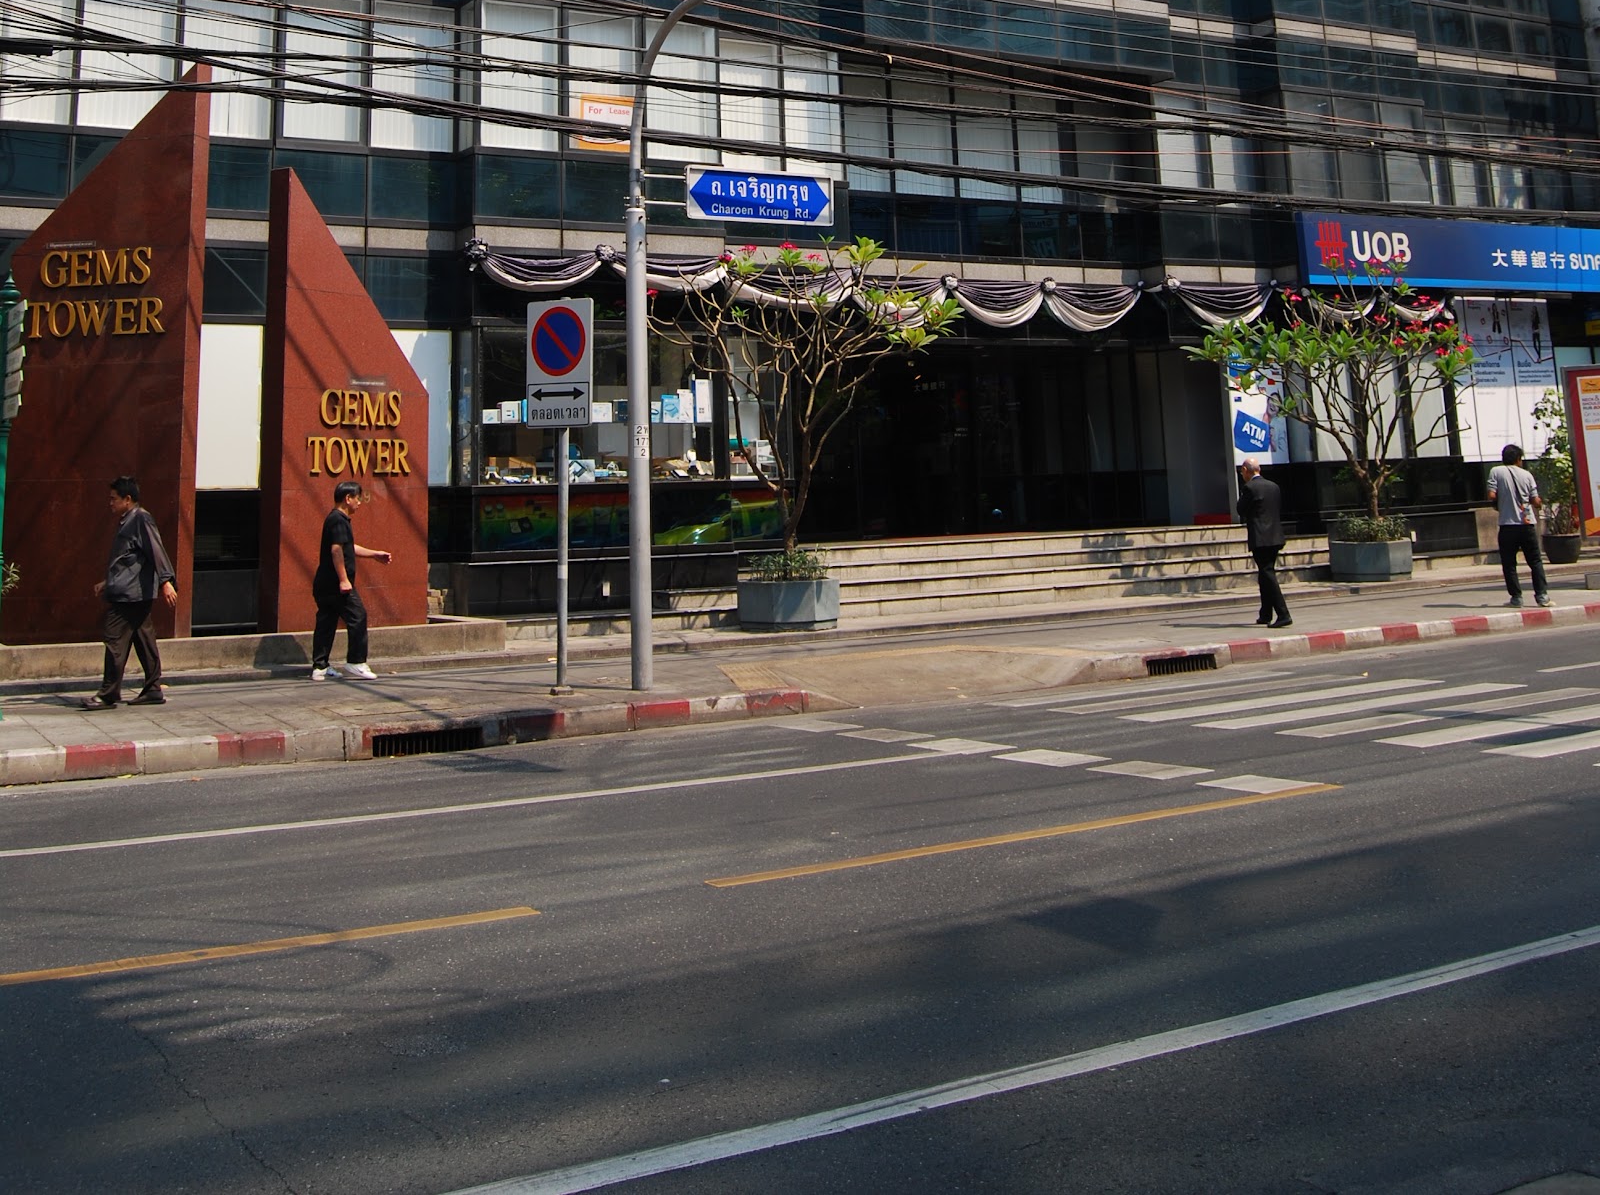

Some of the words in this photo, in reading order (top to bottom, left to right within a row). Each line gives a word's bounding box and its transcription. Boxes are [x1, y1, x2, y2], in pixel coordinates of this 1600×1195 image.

[588, 106, 603, 115] For
[609, 107, 631, 116] Lease
[729, 176, 809, 207] เจริญกรุง
[711, 203, 754, 216] Charoen
[759, 206, 789, 220] Krung
[794, 207, 812, 219] Rd.
[1351, 230, 1412, 264] UOB
[1491, 248, 1566, 270] 大華銀行
[41, 246, 152, 288] GEMS
[28, 297, 166, 338] TOWER
[321, 389, 402, 427] GEMS
[531, 406, 586, 421] ตลอดเวลา
[1242, 421, 1266, 442] ATM
[307, 436, 411, 475] TOWER
[640, 448, 646, 457] 2
